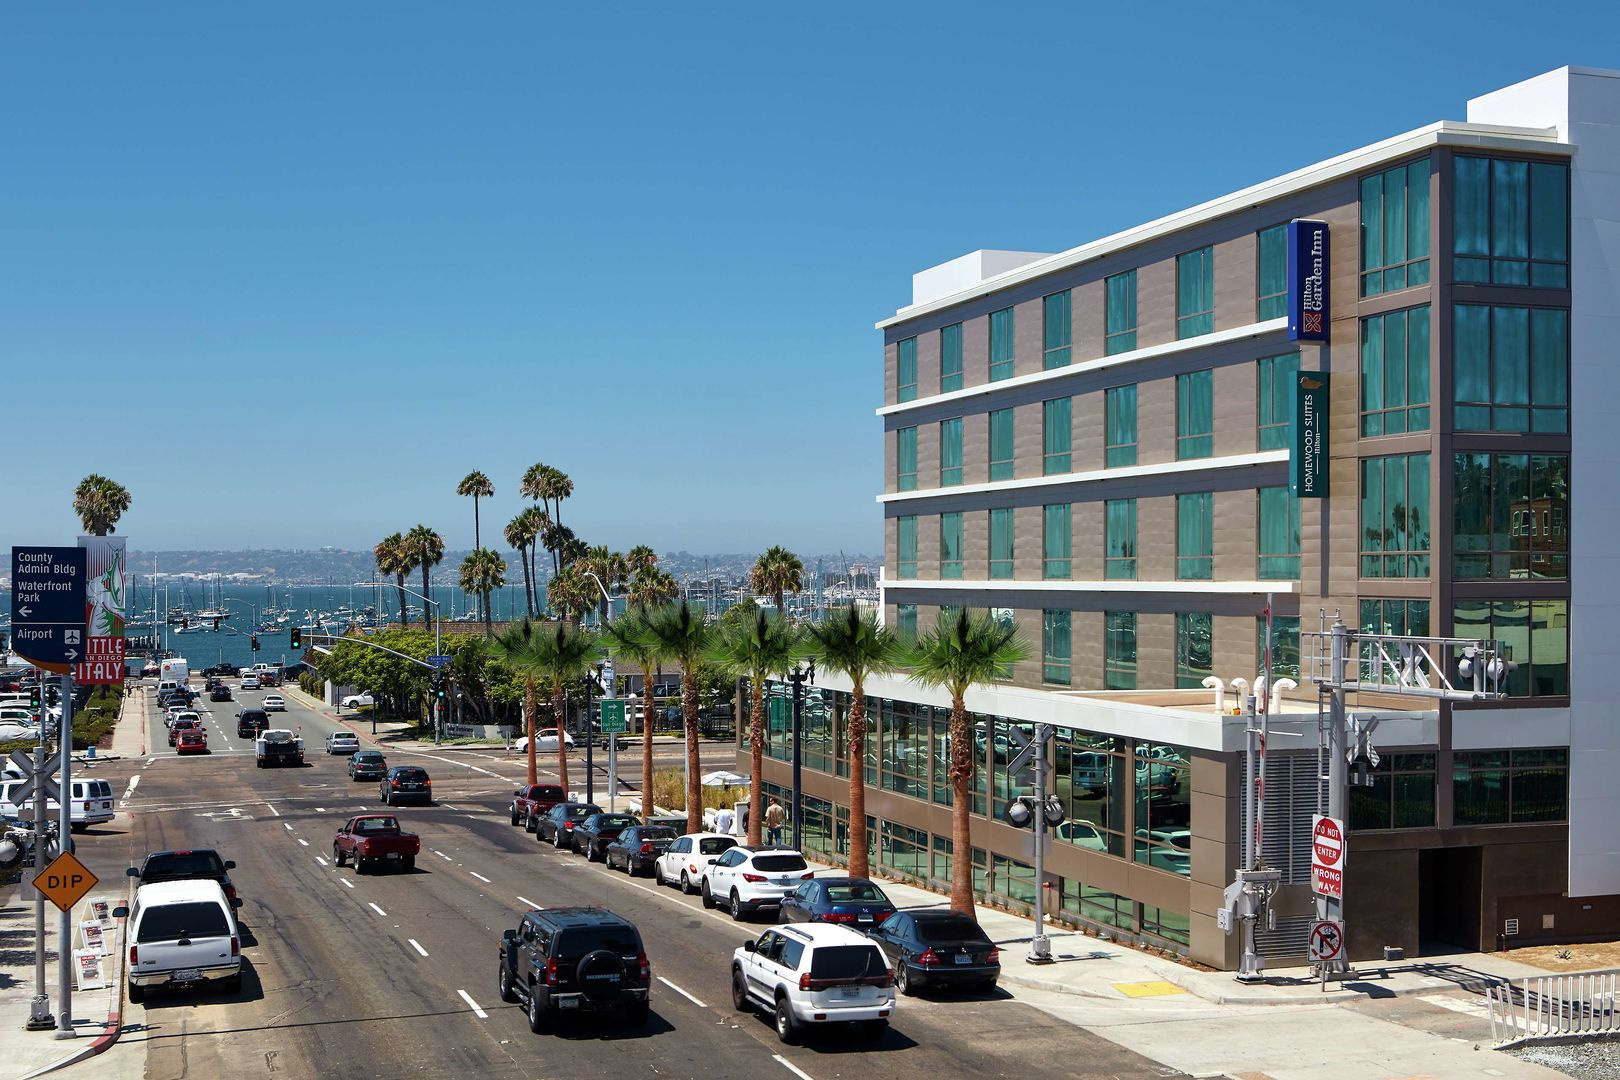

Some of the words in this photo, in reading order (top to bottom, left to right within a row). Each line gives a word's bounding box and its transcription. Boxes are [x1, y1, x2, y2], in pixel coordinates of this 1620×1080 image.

[1311, 229, 1323, 256] Inn
[1311, 257, 1323, 311] Garden
[1303, 277, 1312, 310] Hilton
[1304, 394, 1313, 426] SUITES
[1304, 429, 1313, 492] HOMEWOOD
[18, 552, 53, 564] County
[18, 564, 49, 574] Admin
[54, 564, 76, 576] Bldg
[18, 581, 72, 591] Waterfront
[18, 592, 40, 602] Park
[17, 629, 53, 640] Airport
[87, 638, 122, 654] ITTLE
[79, 662, 122, 680] ITALY
[1317, 825, 1325, 834] DO
[1327, 828, 1339, 838] NOT
[1317, 846, 1337, 859] ENTER
[1313, 867, 1340, 881] WRONG
[48, 875, 83, 889] DIP
[1318, 881, 1334, 893] WAY
